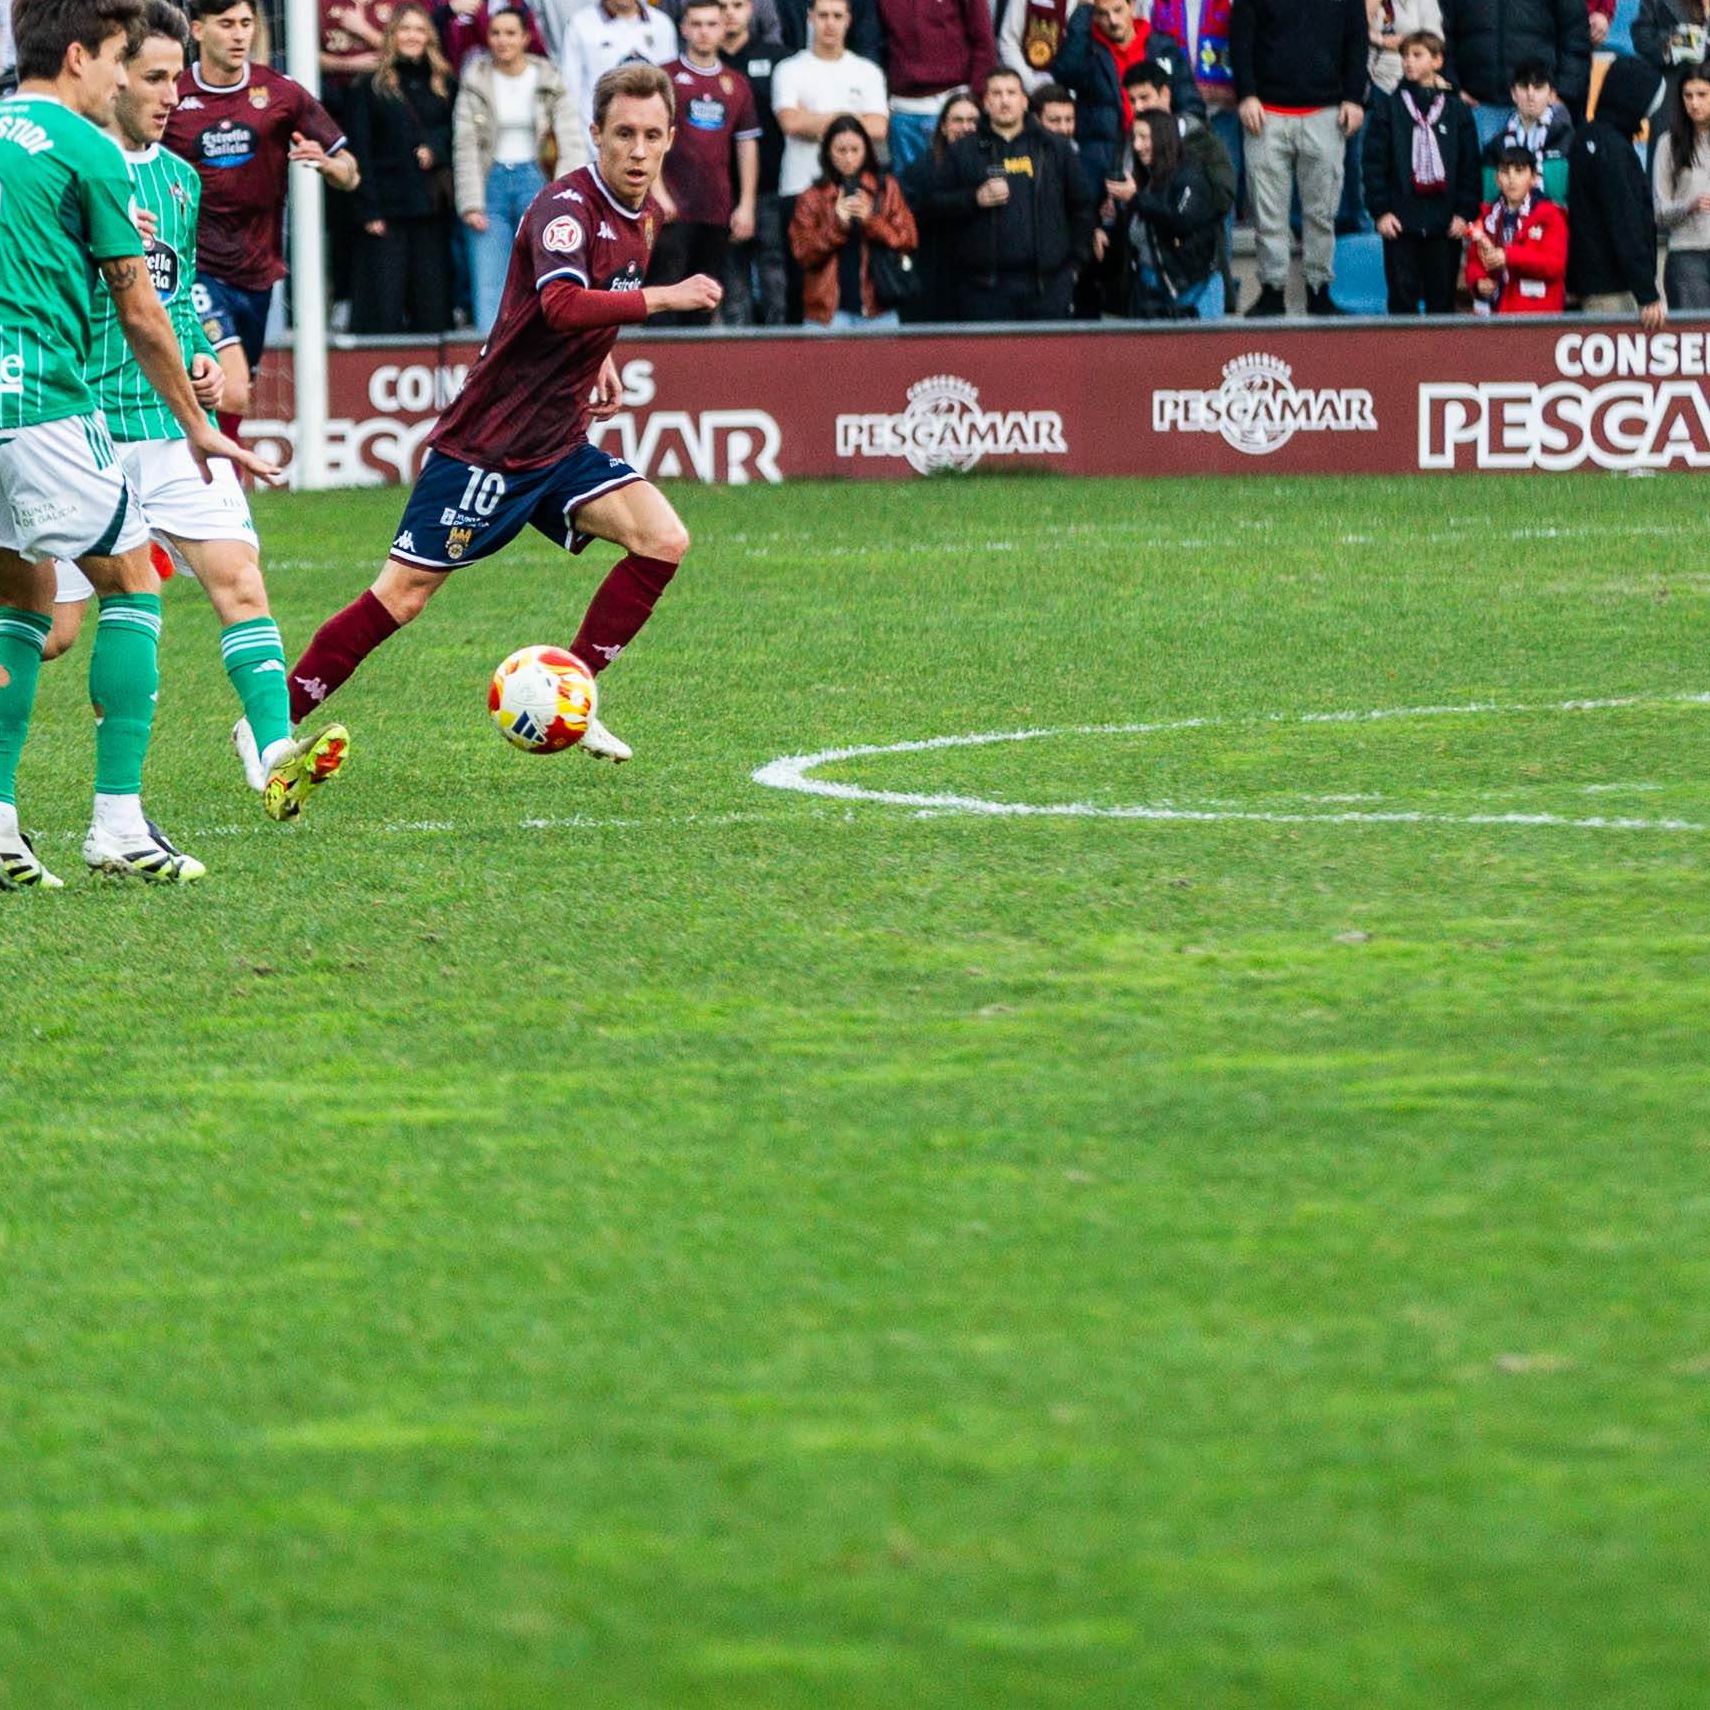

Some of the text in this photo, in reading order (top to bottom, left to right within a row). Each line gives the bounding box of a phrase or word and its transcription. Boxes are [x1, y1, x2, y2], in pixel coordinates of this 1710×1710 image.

[836, 410, 1069, 458] PESCAMAR
[1151, 388, 1379, 433] PESCAMAR
[458, 465, 506, 516] 10
